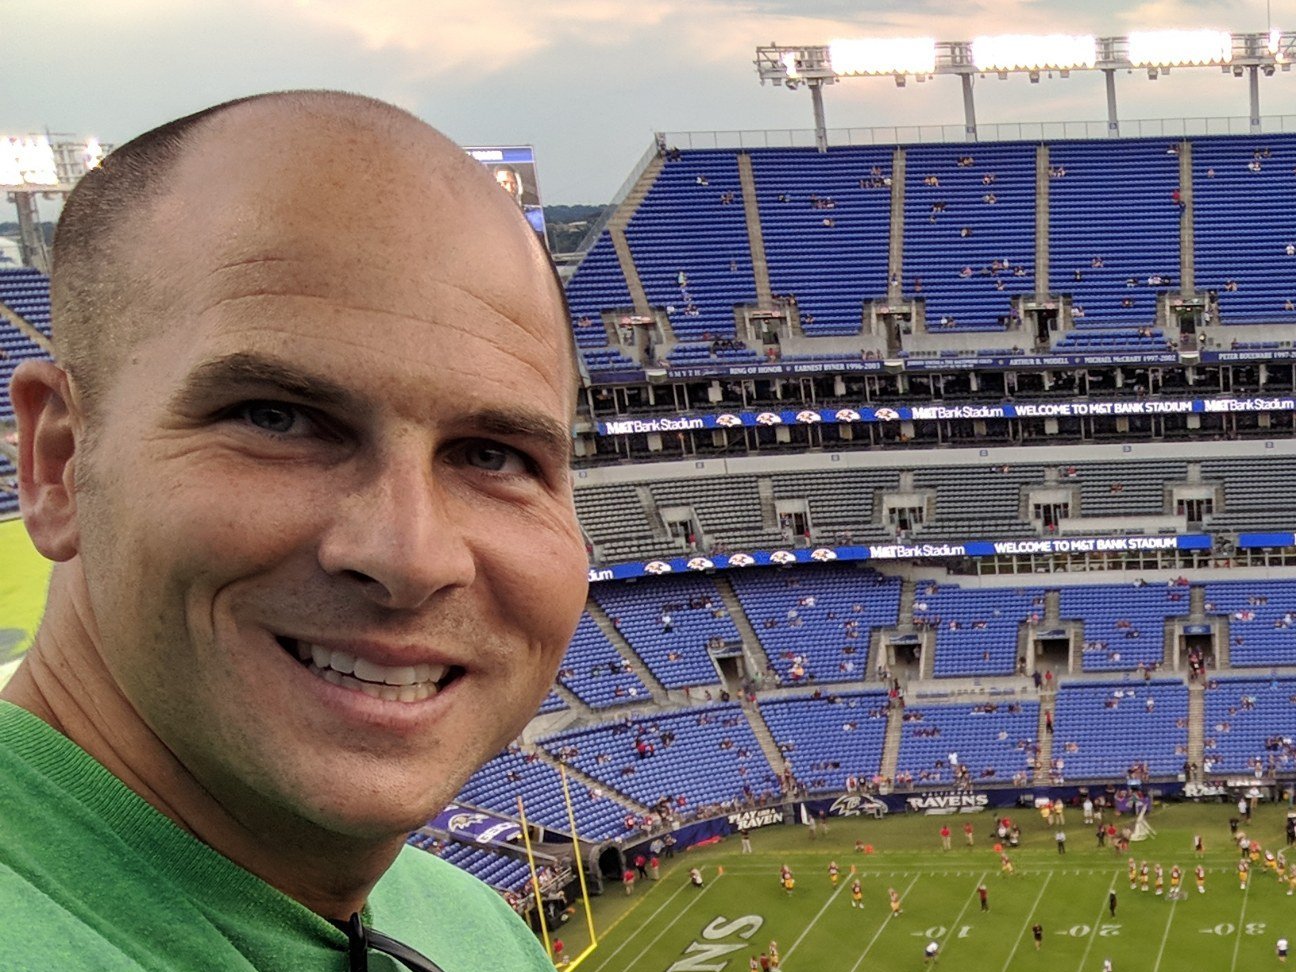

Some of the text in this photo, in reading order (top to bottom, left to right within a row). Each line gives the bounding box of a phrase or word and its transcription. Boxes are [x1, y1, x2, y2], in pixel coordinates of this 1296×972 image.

[1015, 404, 1071, 416] WELCOME
[1073, 404, 1088, 414] TO
[1114, 402, 1145, 414] BANK
[1145, 401, 1192, 412] STADIUM
[1230, 399, 1255, 411] Bank
[1255, 398, 1294, 410] Stadium
[939, 407, 963, 419] Bank
[963, 405, 1003, 418] Stadium
[634, 420, 661, 432] Bank
[661, 418, 703, 430] Stadium
[898, 545, 923, 557] Bank
[923, 544, 965, 556] Stadium
[994, 541, 1051, 553] WELCOME
[1053, 540, 1070, 551] TO
[1097, 539, 1128, 550] BANK
[1128, 537, 1177, 549] STADIUM
[906, 794, 989, 808] RAVENS
[738, 812, 783, 831] RAVEN
